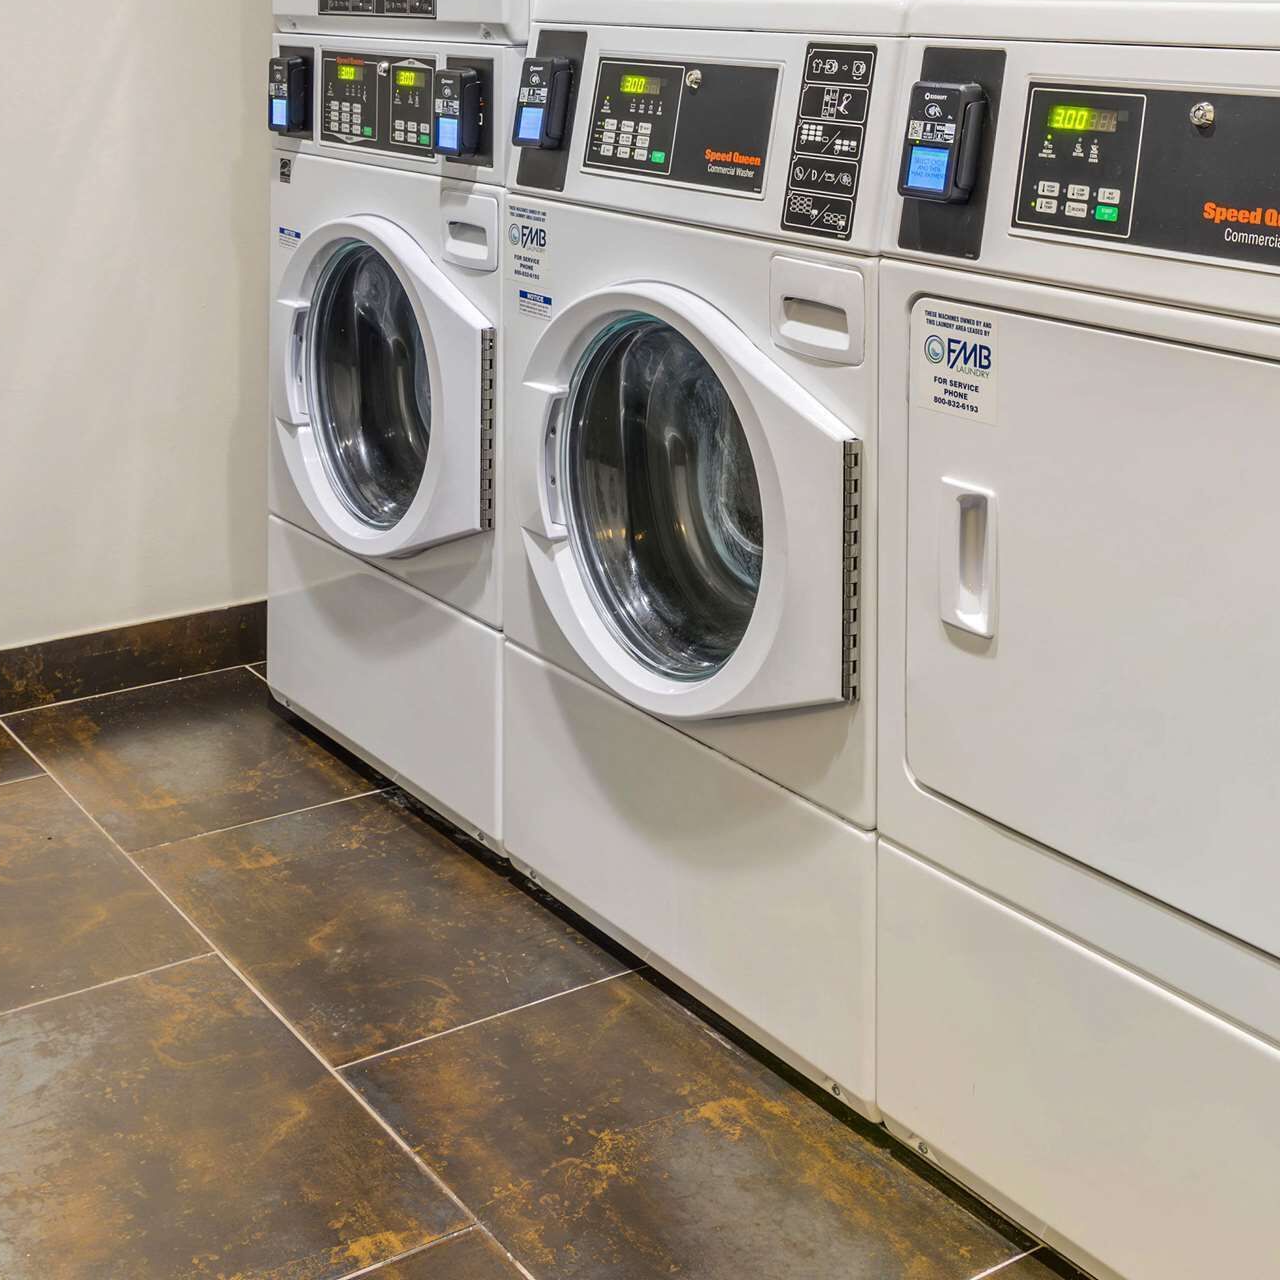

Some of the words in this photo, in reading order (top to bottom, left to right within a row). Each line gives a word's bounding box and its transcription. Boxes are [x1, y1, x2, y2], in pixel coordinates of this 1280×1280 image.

[704, 148, 732, 162] Speed
[732, 151, 761, 167] Queen
[707, 163, 735, 176] Commercial
[736, 167, 755, 178] Washer
[1203, 201, 1263, 224] Speed
[521, 225, 547, 249] FMB
[936, 320, 955, 330] LAUNDRY
[947, 337, 991, 370] FMB
[956, 364, 990, 379] LAUNDRY
[933, 375, 948, 385] FOR
[949, 379, 980, 393] SERVICE
[943, 388, 968, 401] PHONE
[933, 396, 979, 413] 800-832-6193
